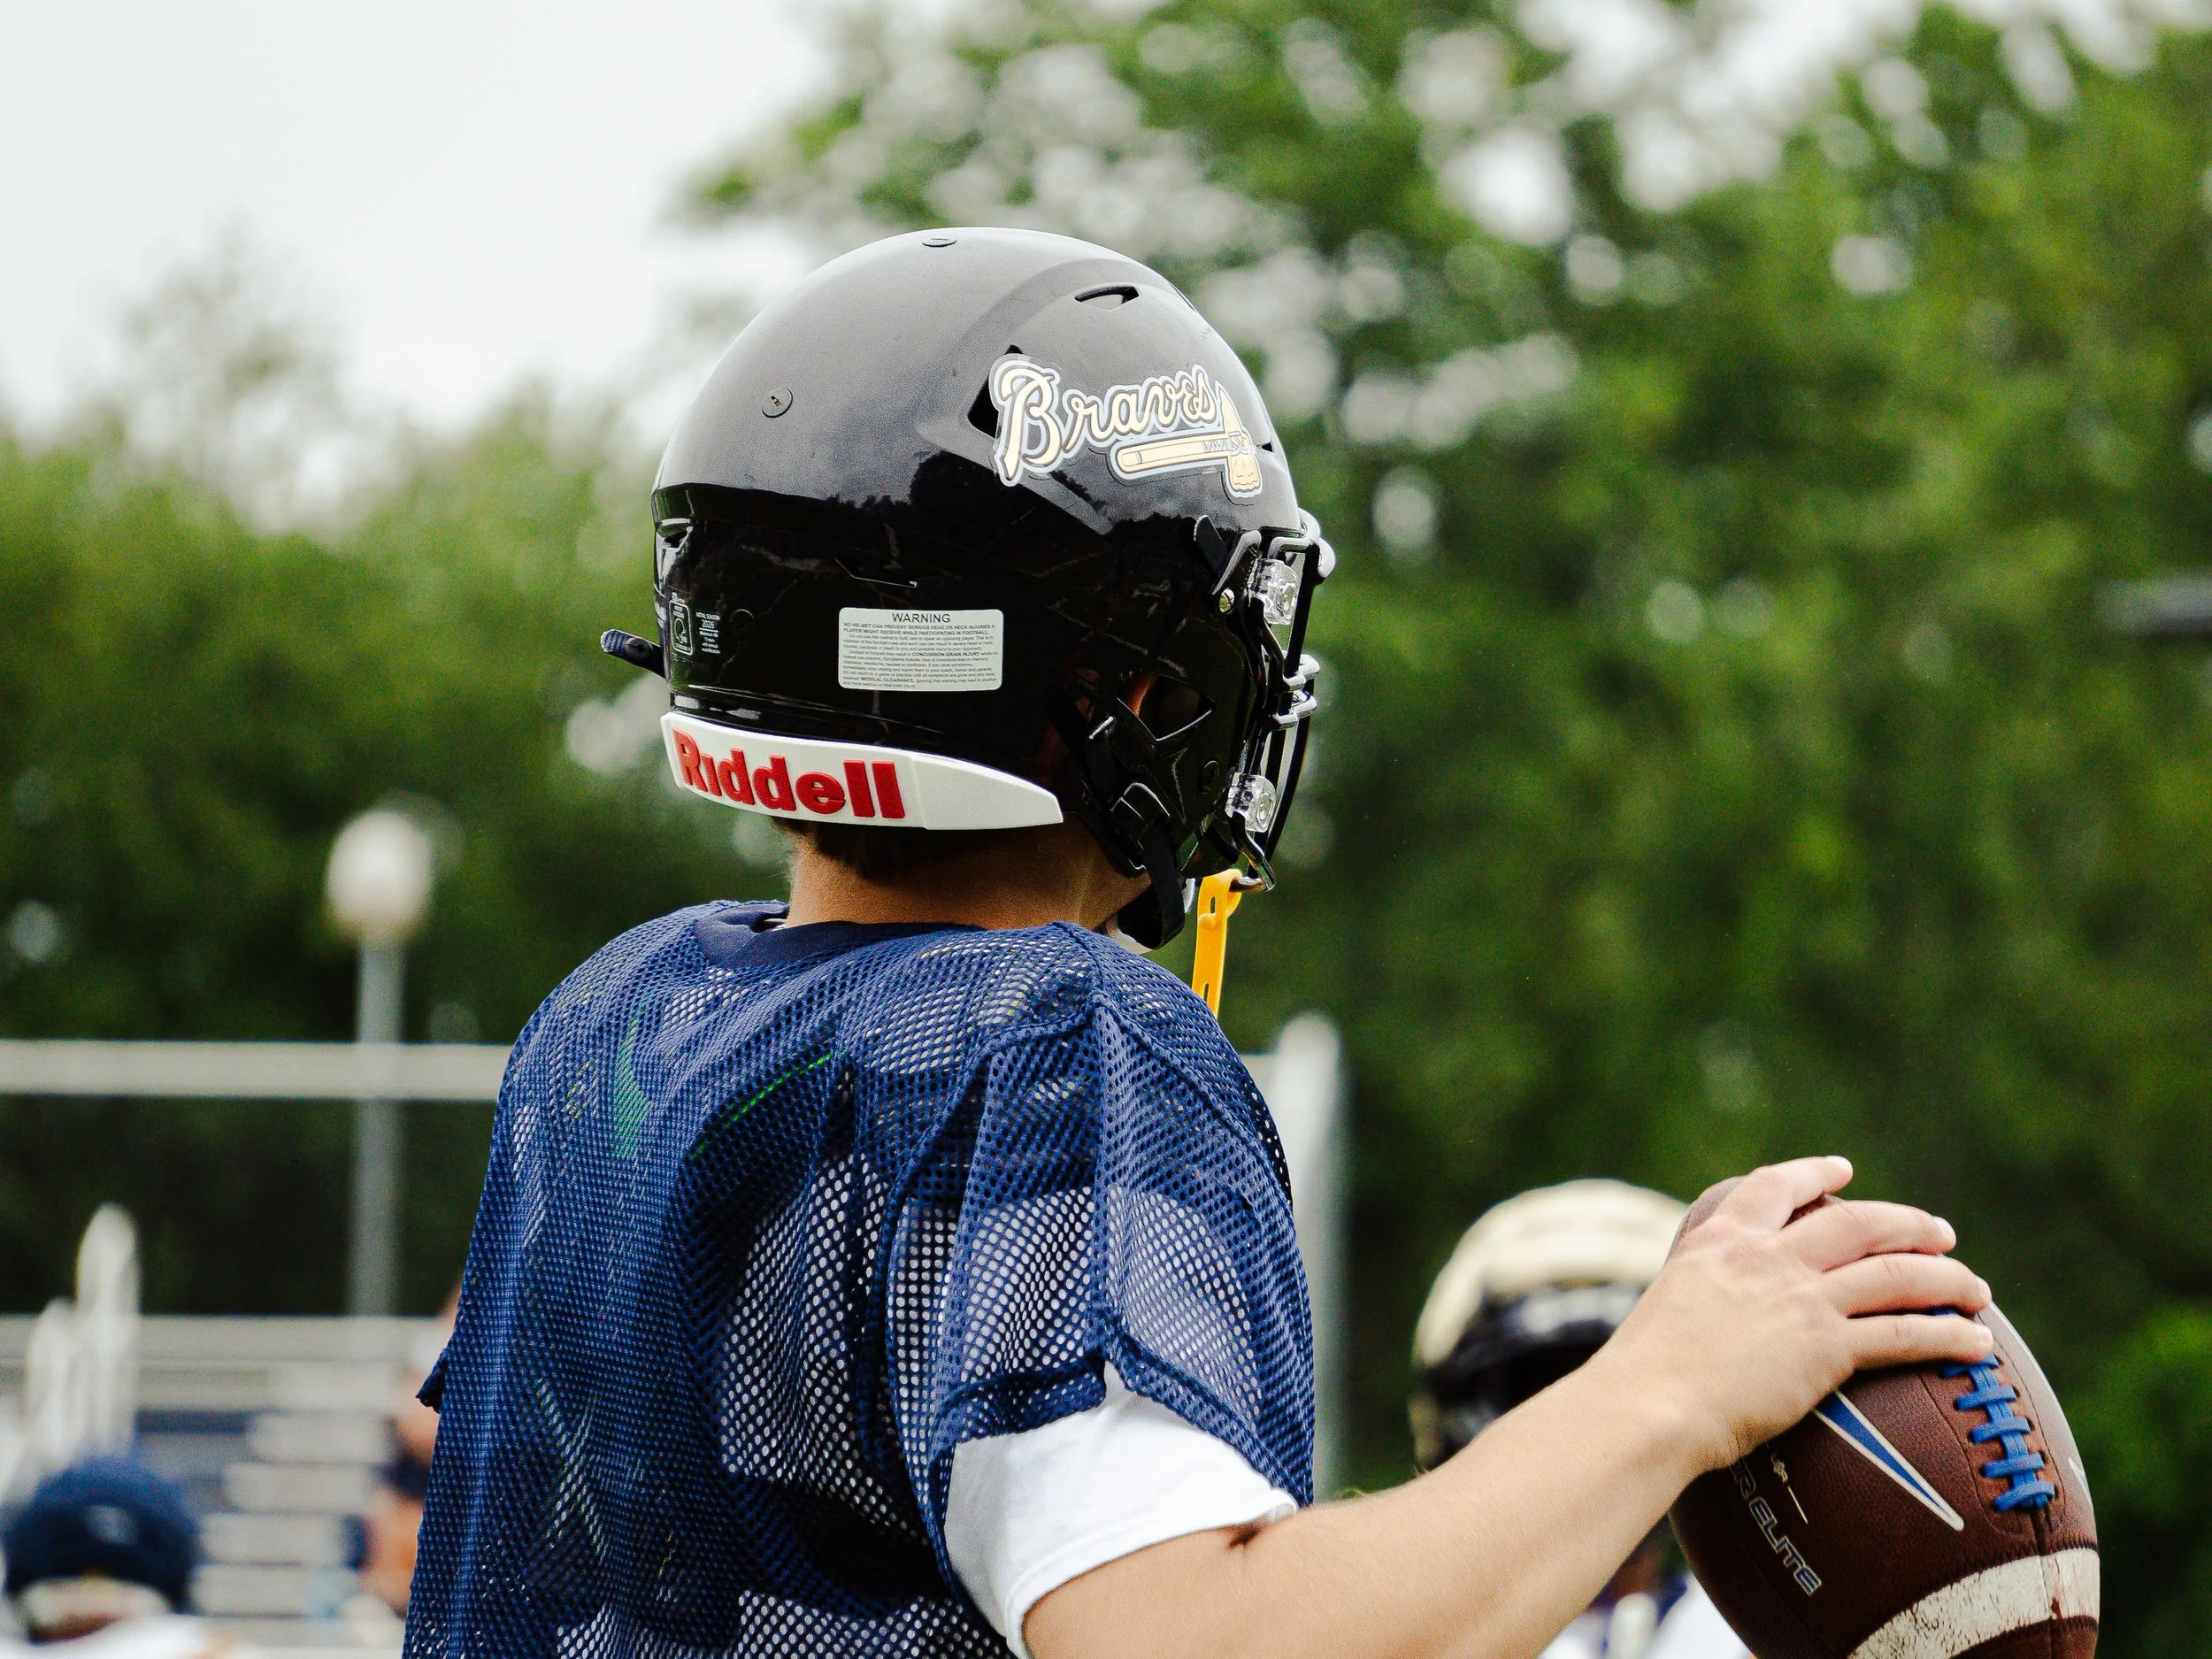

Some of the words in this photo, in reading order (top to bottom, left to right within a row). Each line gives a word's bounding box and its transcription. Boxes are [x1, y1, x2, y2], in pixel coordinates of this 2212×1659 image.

[995, 362, 1220, 485] Braves
[891, 612, 950, 623] WARNING
[672, 726, 906, 819] Riddell
[1748, 1496, 1823, 1597] ELITE
